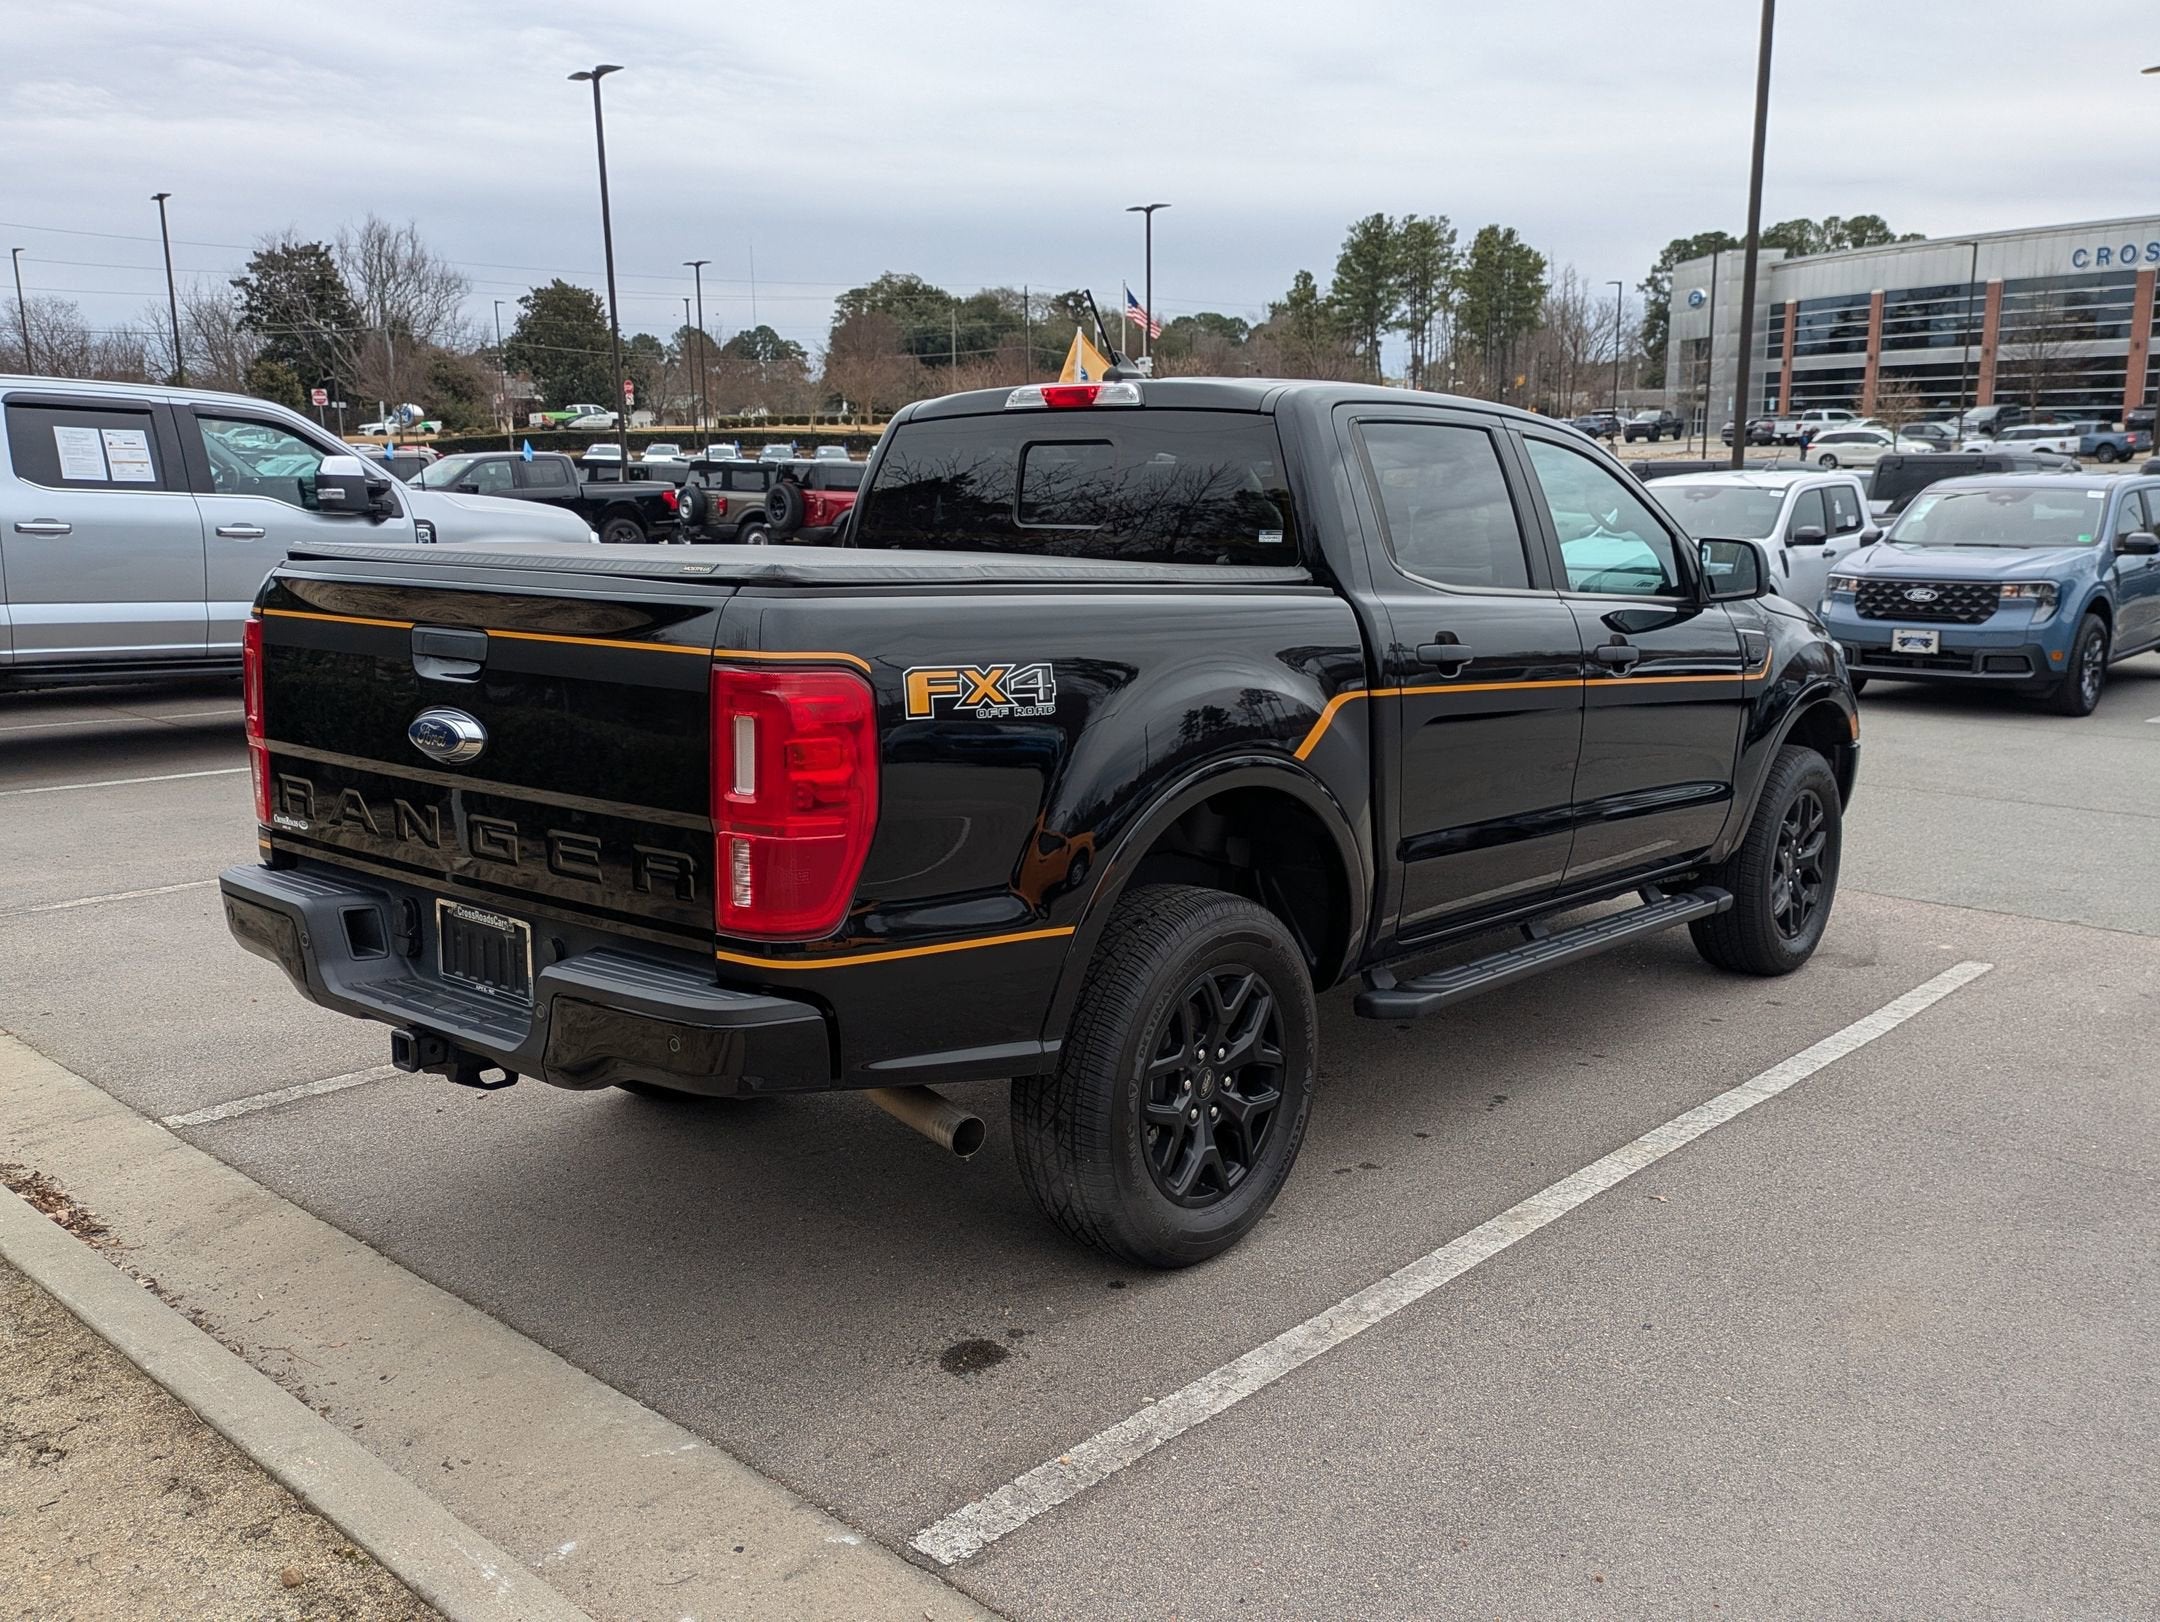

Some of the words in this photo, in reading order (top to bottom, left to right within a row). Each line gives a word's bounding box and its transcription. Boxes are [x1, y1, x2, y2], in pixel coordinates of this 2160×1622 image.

[903, 663, 1056, 720] FX4
[976, 707, 1010, 718] OFF
[1014, 705, 1056, 717] ROAD
[416, 722, 448, 747] Ford
[278, 772, 697, 902] RANGER
